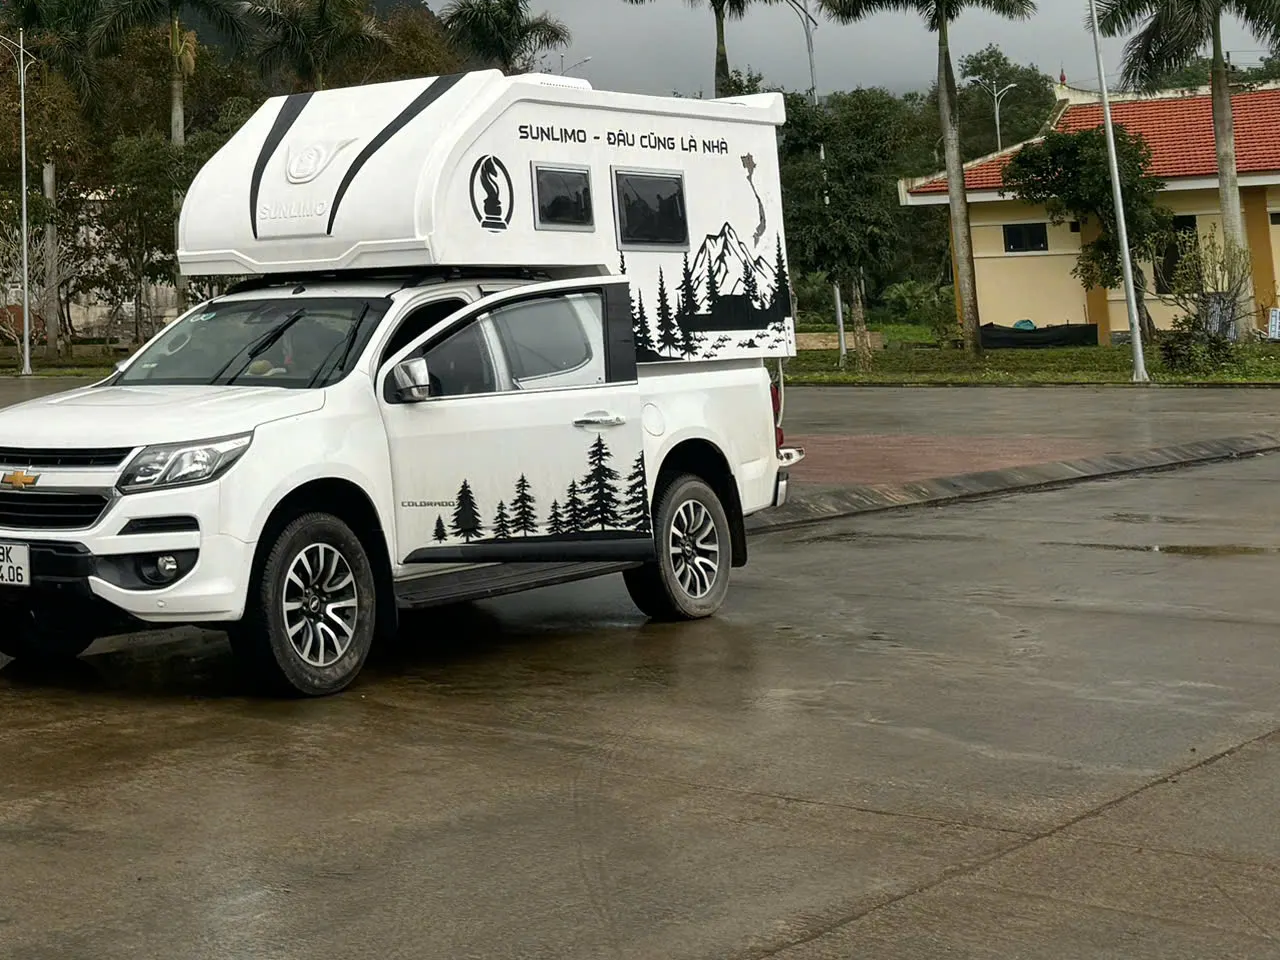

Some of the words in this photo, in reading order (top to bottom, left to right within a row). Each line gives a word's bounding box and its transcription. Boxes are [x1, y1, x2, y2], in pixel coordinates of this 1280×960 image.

[518, 124, 587, 144] SUNLIMO
[606, 129, 635, 147] ĐÂU
[639, 132, 676, 151] CŨNG
[680, 135, 698, 153] LÀ
[702, 137, 729, 155] NHÀ
[259, 200, 328, 220] SUNLIMO
[401, 500, 456, 508] COLORADO
